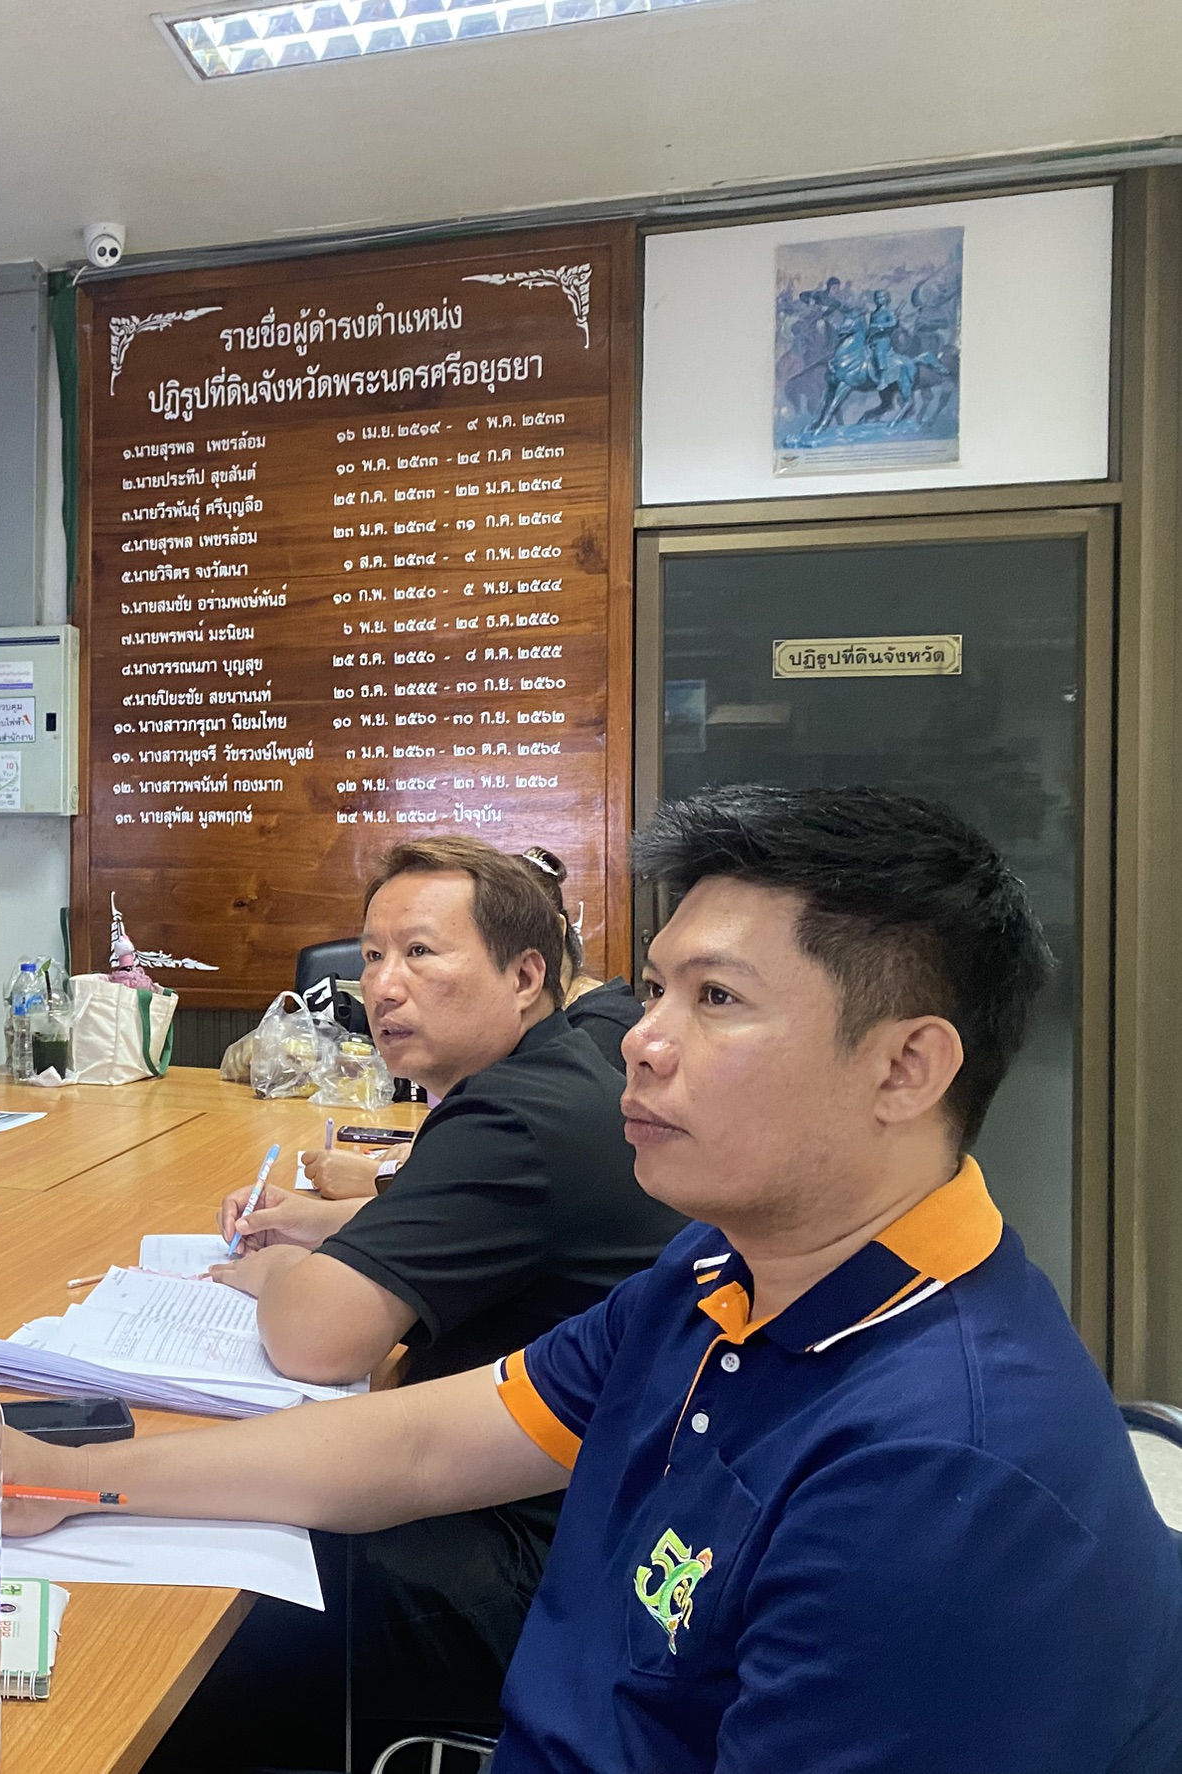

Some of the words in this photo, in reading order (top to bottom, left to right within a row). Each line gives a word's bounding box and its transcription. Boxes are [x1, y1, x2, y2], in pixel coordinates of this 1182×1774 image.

[219, 296, 463, 357] รายชื่อผู้ดำรงตำแหน่ง
[147, 350, 543, 423] ปฏิรูปที่ดินจังหวัดพระนครศรีอยุธยา
[206, 429, 266, 453] เพชรล้อม
[336, 428, 356, 444] ๑๖
[361, 425, 395, 440] เม.ย.
[486, 414, 517, 430] พ.ค.
[521, 411, 565, 427] ๒๕๓๓
[122, 467, 205, 491] ๒.นายประทีป
[210, 461, 258, 490] สุขสันต์
[335, 463, 356, 476] ๑๐
[361, 457, 391, 472] พ.ค.
[396, 454, 439, 470] ๒๕๓๓
[521, 445, 565, 461] ๒๕๓๓
[359, 489, 388, 504] ก.ค.
[394, 487, 436, 502] ๒๕๓๓
[455, 483, 480, 497] ๒๒
[485, 480, 516, 495] ม.ค.
[198, 525, 258, 548] เพชรล้อม
[333, 525, 355, 539] ๒๓
[359, 522, 389, 537] ม.ค.
[455, 519, 476, 532] ๓๑
[485, 513, 515, 528] ก.ค.
[194, 559, 249, 579] จงวัฒนา
[343, 559, 354, 572] ๑
[359, 554, 387, 570] ส.ค.
[485, 546, 515, 561] ก.พ.
[517, 544, 562, 560] ๒๕๔๐
[332, 592, 352, 605] ๑๐
[358, 588, 387, 602] ก.พ.
[393, 585, 437, 601] ๒๕๔๐
[482, 580, 514, 595] พ.ย.
[207, 623, 255, 642] มะนิยม
[343, 622, 353, 636] ๖
[358, 620, 388, 635] พ.ย.
[485, 613, 515, 629] ธ.ค.
[221, 657, 263, 678] บุญสุข
[358, 652, 386, 667] ธ.ค.
[484, 646, 514, 661] ต.ค.
[789, 645, 945, 670] ปฏิรูปที่ดินจังหวัด
[208, 679, 273, 705] สยนานนท์
[333, 686, 355, 700] ๒๐
[360, 684, 388, 698] ธ.ค.
[455, 681, 478, 694] ๓๐
[483, 677, 514, 692] ก.ย.
[519, 676, 567, 691] ๒๕๖๐
[113, 722, 136, 735] ๑๐.
[137, 717, 227, 738] นางสาวกรุณา
[231, 709, 288, 731] นิยมไทย
[332, 716, 352, 730] ๑๐
[359, 713, 389, 727] พ.ย.
[394, 712, 437, 727] ๒๕๖๐
[452, 713, 474, 725] ๓๐
[479, 710, 511, 725] ก.ย.
[111, 752, 135, 764] ๑๑.
[345, 749, 356, 760] ๓
[360, 745, 389, 760] ม.ค.
[452, 743, 476, 757] ๒๐
[481, 742, 512, 756] ต.ค.
[233, 778, 284, 793] กองมาก
[361, 778, 390, 792] พ.ย.
[480, 775, 510, 789] พ.ย.
[139, 805, 194, 830] นายสุพัฒ
[198, 803, 254, 830] มูลพฤกษ์
[362, 810, 391, 824] พ.ย.
[452, 802, 502, 829] ปัจจุบัน
